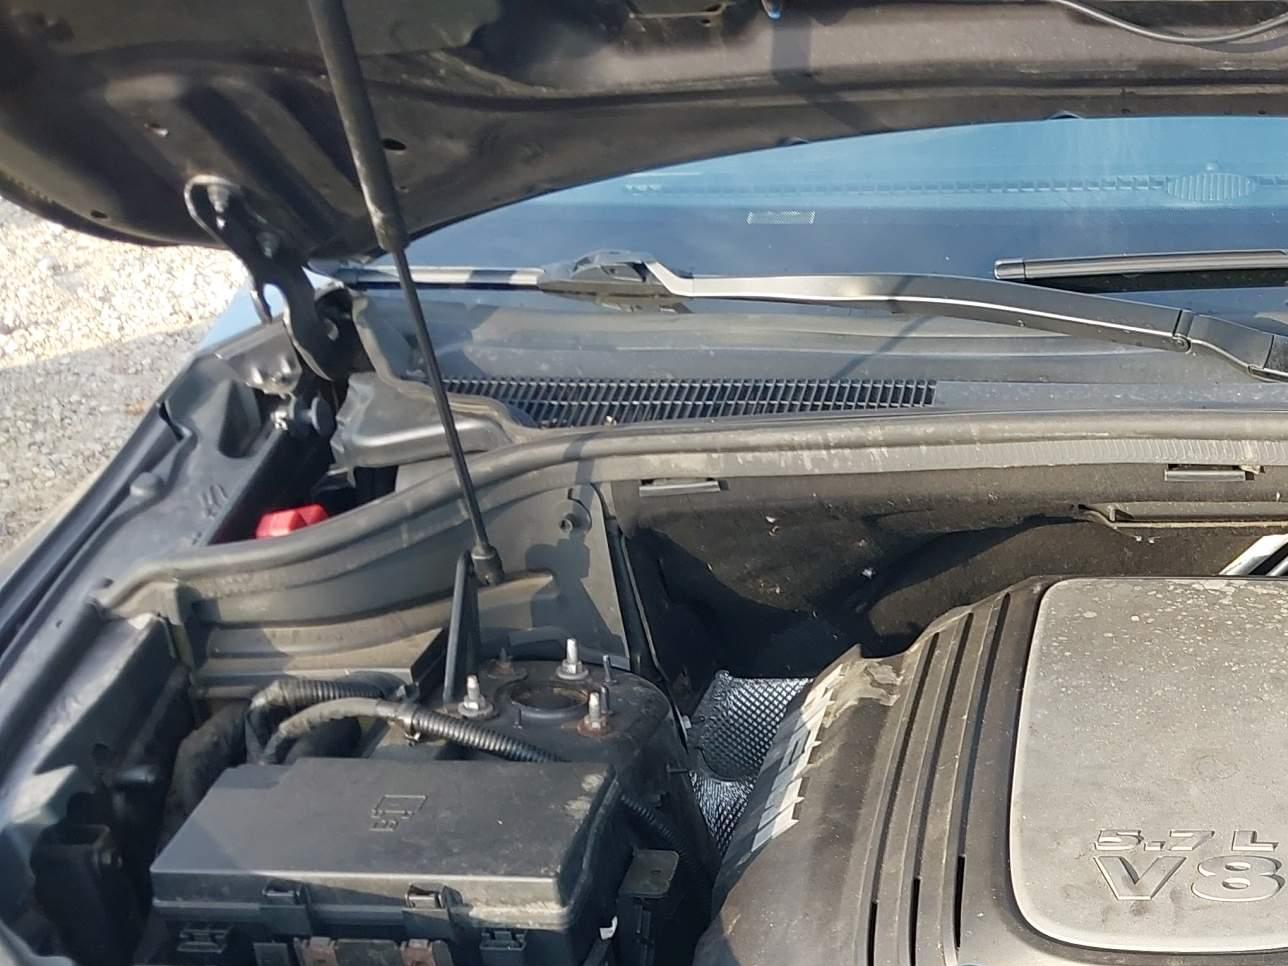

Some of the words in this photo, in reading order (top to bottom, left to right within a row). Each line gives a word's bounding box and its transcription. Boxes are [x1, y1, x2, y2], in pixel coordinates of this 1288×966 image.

[1093, 828, 1216, 851] 5.7
[1231, 828, 1280, 852] L
[1093, 855, 1286, 902] V8
